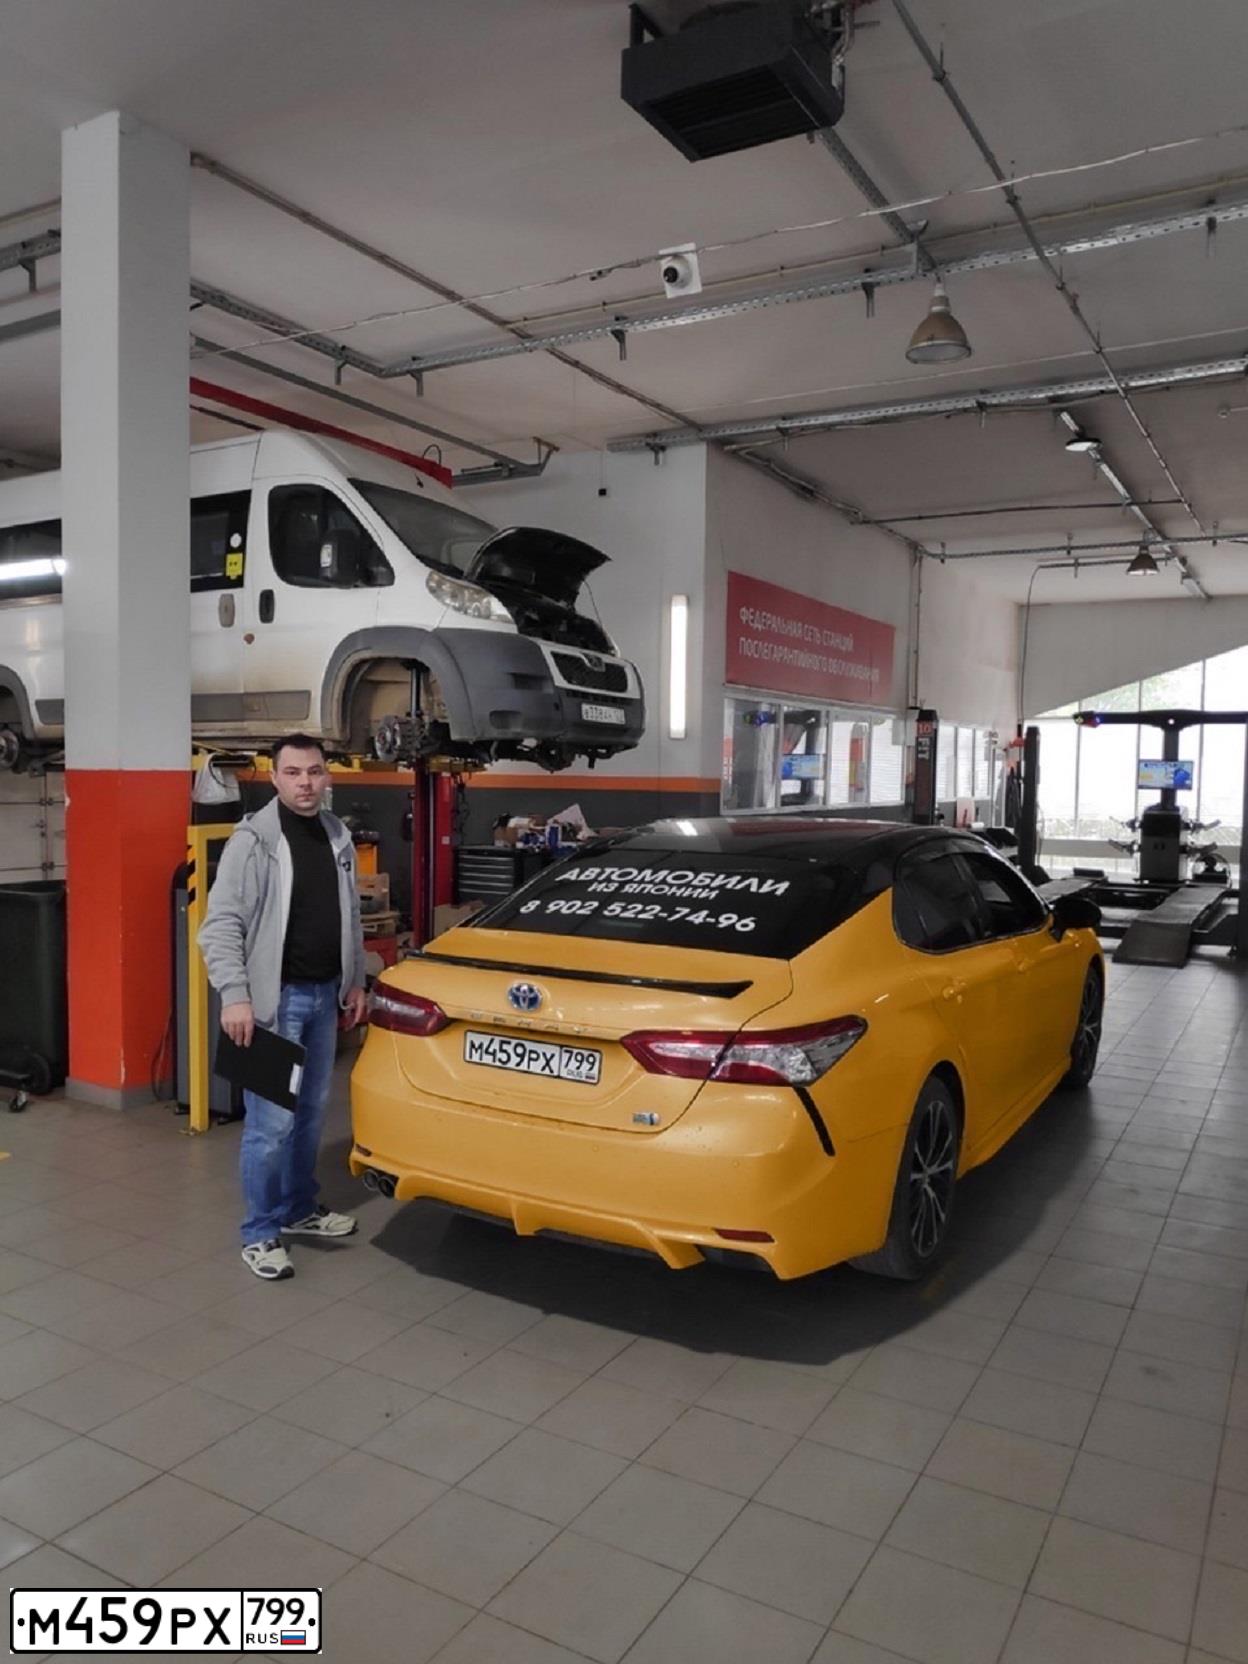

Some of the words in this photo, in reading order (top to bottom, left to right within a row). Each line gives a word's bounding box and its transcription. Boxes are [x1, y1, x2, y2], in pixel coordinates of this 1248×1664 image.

[554, 867, 790, 896] АВТОМОБИЛИ
[587, 881, 619, 893] ИЗ
[620, 882, 720, 900] ЯПОНИИ
[519, 900, 541, 914] 8
[544, 900, 600, 915] 902
[602, 902, 757, 932] 522-74-96
[468, 1037, 556, 1074] М459РХ
[563, 1049, 597, 1072] 799
